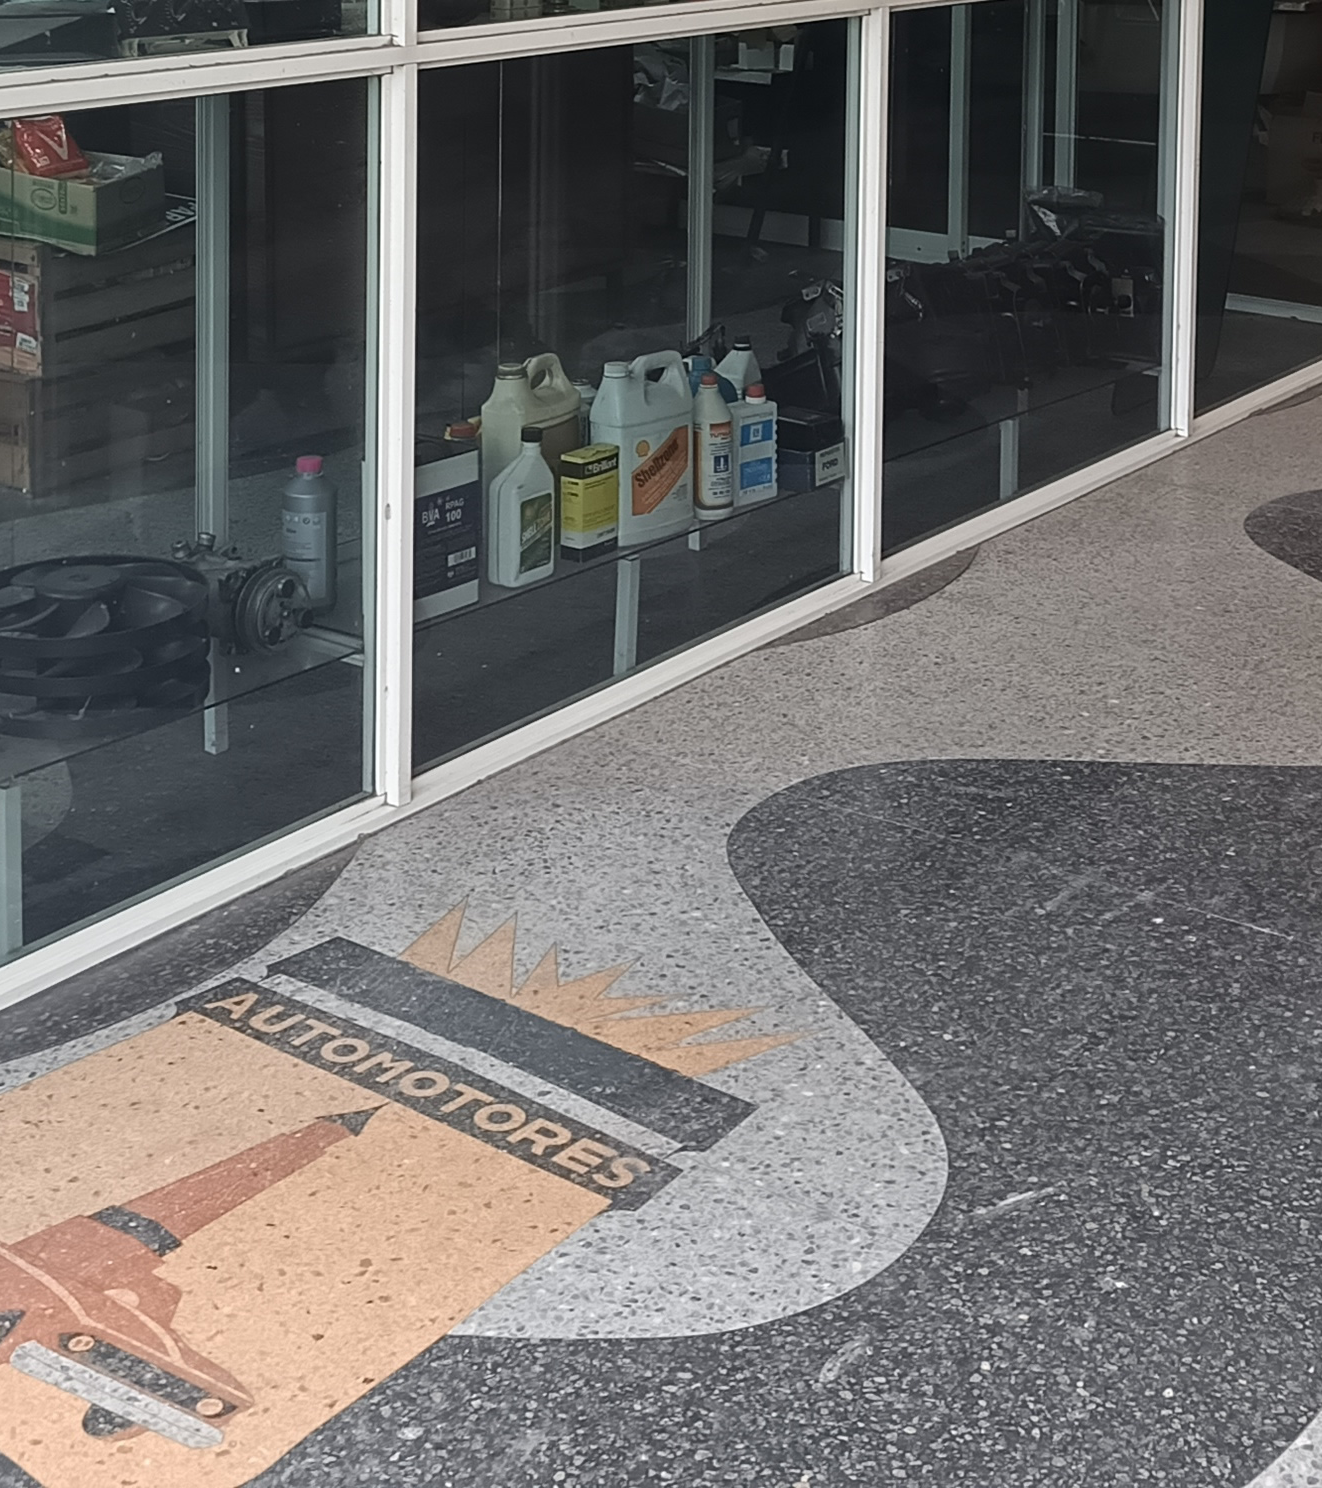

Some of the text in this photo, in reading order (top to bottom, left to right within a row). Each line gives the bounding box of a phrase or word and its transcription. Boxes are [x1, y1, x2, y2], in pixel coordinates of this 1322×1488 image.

[634, 439, 679, 488] Shellzone
[445, 509, 462, 523] 100
[204, 992, 653, 1190] AUTOMOTORES
